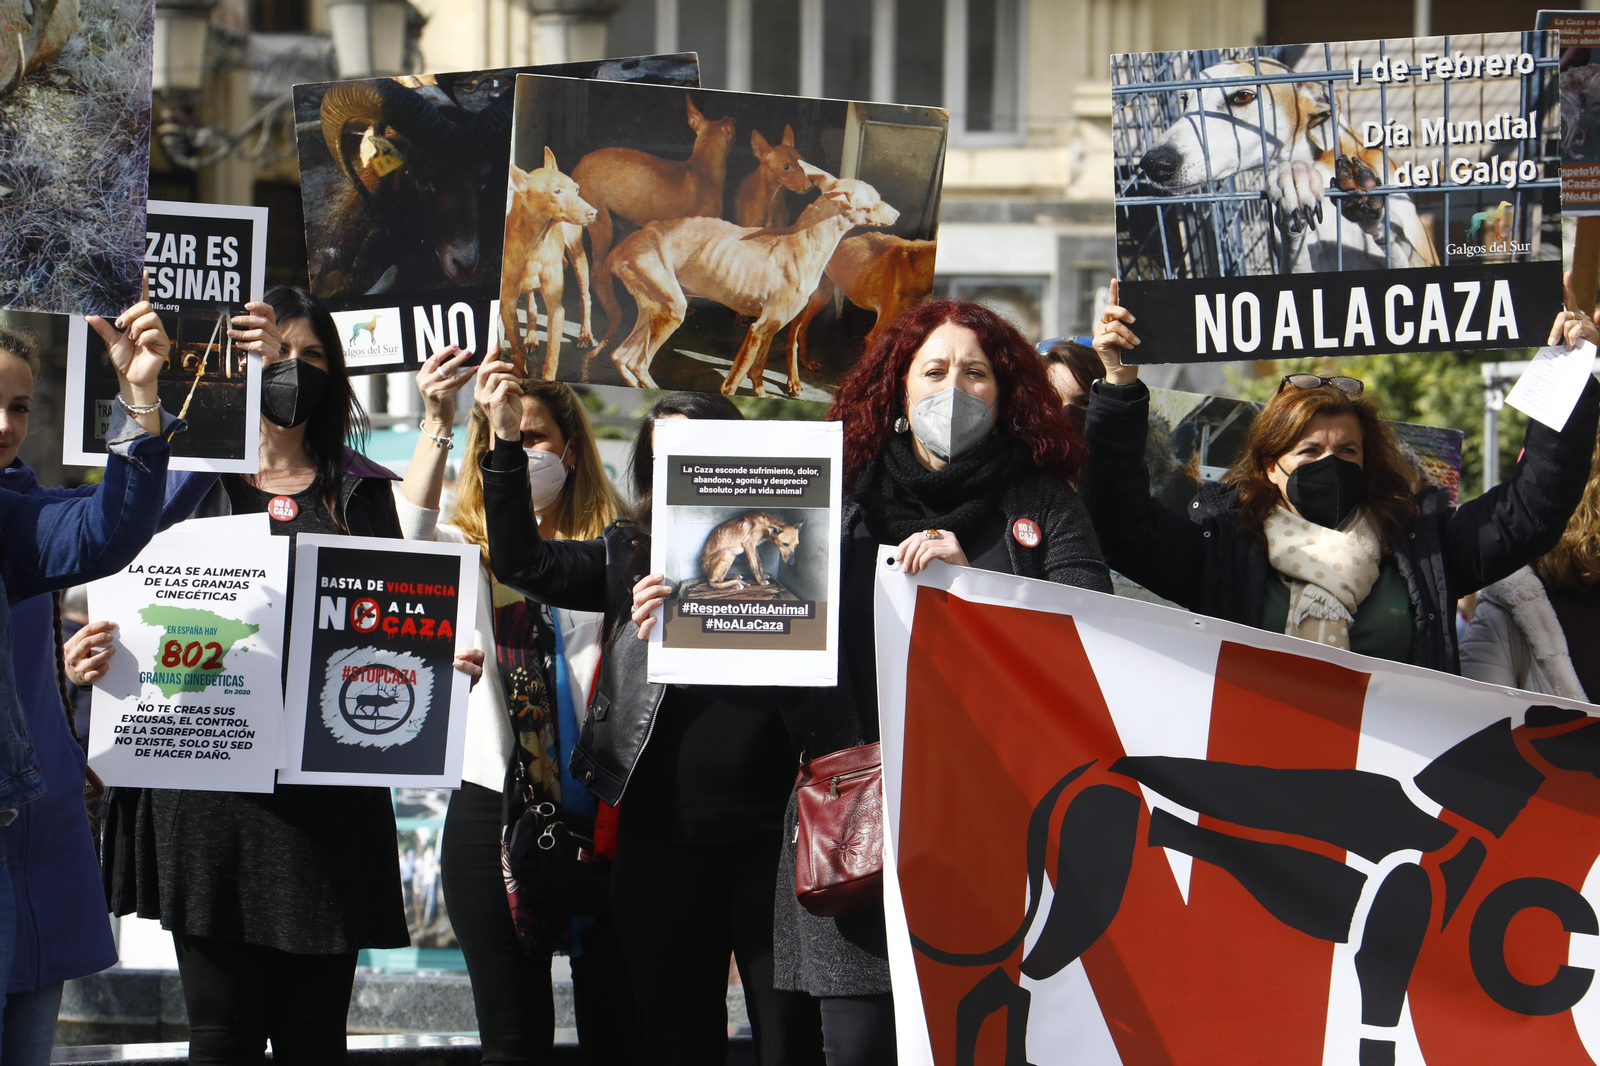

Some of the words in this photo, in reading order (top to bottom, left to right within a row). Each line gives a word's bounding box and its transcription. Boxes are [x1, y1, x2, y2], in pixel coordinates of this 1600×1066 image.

[1351, 57, 1361, 84] 1
[1372, 55, 1409, 82] de
[1421, 51, 1535, 80] Febrero
[1362, 117, 1410, 148] Día
[1421, 110, 1537, 145] Mundial
[1394, 158, 1440, 187] del
[1451, 155, 1537, 189] Galgo
[206, 235, 239, 267] ES
[1446, 243, 1486, 257] Galgos
[1489, 241, 1507, 252] del
[1510, 240, 1531, 252] Sur
[1195, 292, 1261, 354] NO
[1272, 290, 1304, 350] A
[1312, 286, 1375, 348] LA
[1384, 280, 1519, 345] CAZA
[413, 302, 476, 363] NO
[367, 345, 380, 355] del
[383, 344, 398, 354] Sur
[749, 466, 796, 475] sufrimiento,
[797, 467, 819, 476] dolor,
[693, 476, 734, 485] abandono,
[735, 476, 762, 485] agonía
[770, 477, 808, 486] desprecio
[699, 486, 733, 494] absoluto
[776, 487, 802, 495] animal
[274, 499, 284, 507] NO
[273, 507, 294, 517] CAZA
[1018, 523, 1028, 531] NO
[1019, 532, 1038, 542] CAZA
[128, 564, 144, 574] LA
[148, 565, 181, 575] CAZA
[185, 567, 201, 576] SE
[203, 568, 267, 578] ALIMENTA
[144, 577, 162, 586] DE
[165, 578, 188, 587] LAS
[191, 579, 250, 589] GRANJAS
[321, 577, 362, 590] BASTA
[367, 580, 384, 591] DE
[386, 582, 455, 596] VIOLENCIA
[155, 589, 238, 601] CINEGÉTICAS
[388, 602, 399, 613] A
[405, 603, 425, 614] LA
[682, 603, 809, 616] #RespetoVidaAnimal
[167, 625, 176, 634] EN
[178, 625, 203, 635] ESPAÑA
[204, 627, 218, 636] HAY
[382, 616, 453, 640] CAZA
[706, 619, 783, 631] #NoALaCaza
[162, 640, 223, 670] 802
[140, 671, 182, 685] GRANJAS
[184, 672, 245, 687] CINEGÉTICAS
[342, 665, 417, 685] #STOPCAZA
[137, 704, 154, 712] NO
[157, 704, 171, 713] TE
[174, 705, 210, 715] CREAS
[213, 706, 235, 716] SUS
[121, 714, 176, 726] EXCUSAS,
[179, 717, 192, 725] EL
[195, 717, 249, 728] CONTROL
[114, 726, 130, 734] DE
[132, 726, 147, 735] LA
[150, 726, 255, 739] SOBREPOBLACIÓN
[115, 736, 132, 745] NO
[135, 738, 176, 748] EXISTE,
[179, 739, 210, 748] SOLO
[212, 740, 228, 749] SU
[230, 741, 253, 750] SED
[134, 748, 151, 757] DE
[153, 749, 192, 759] HACER
[194, 750, 231, 760] DAÑO.
